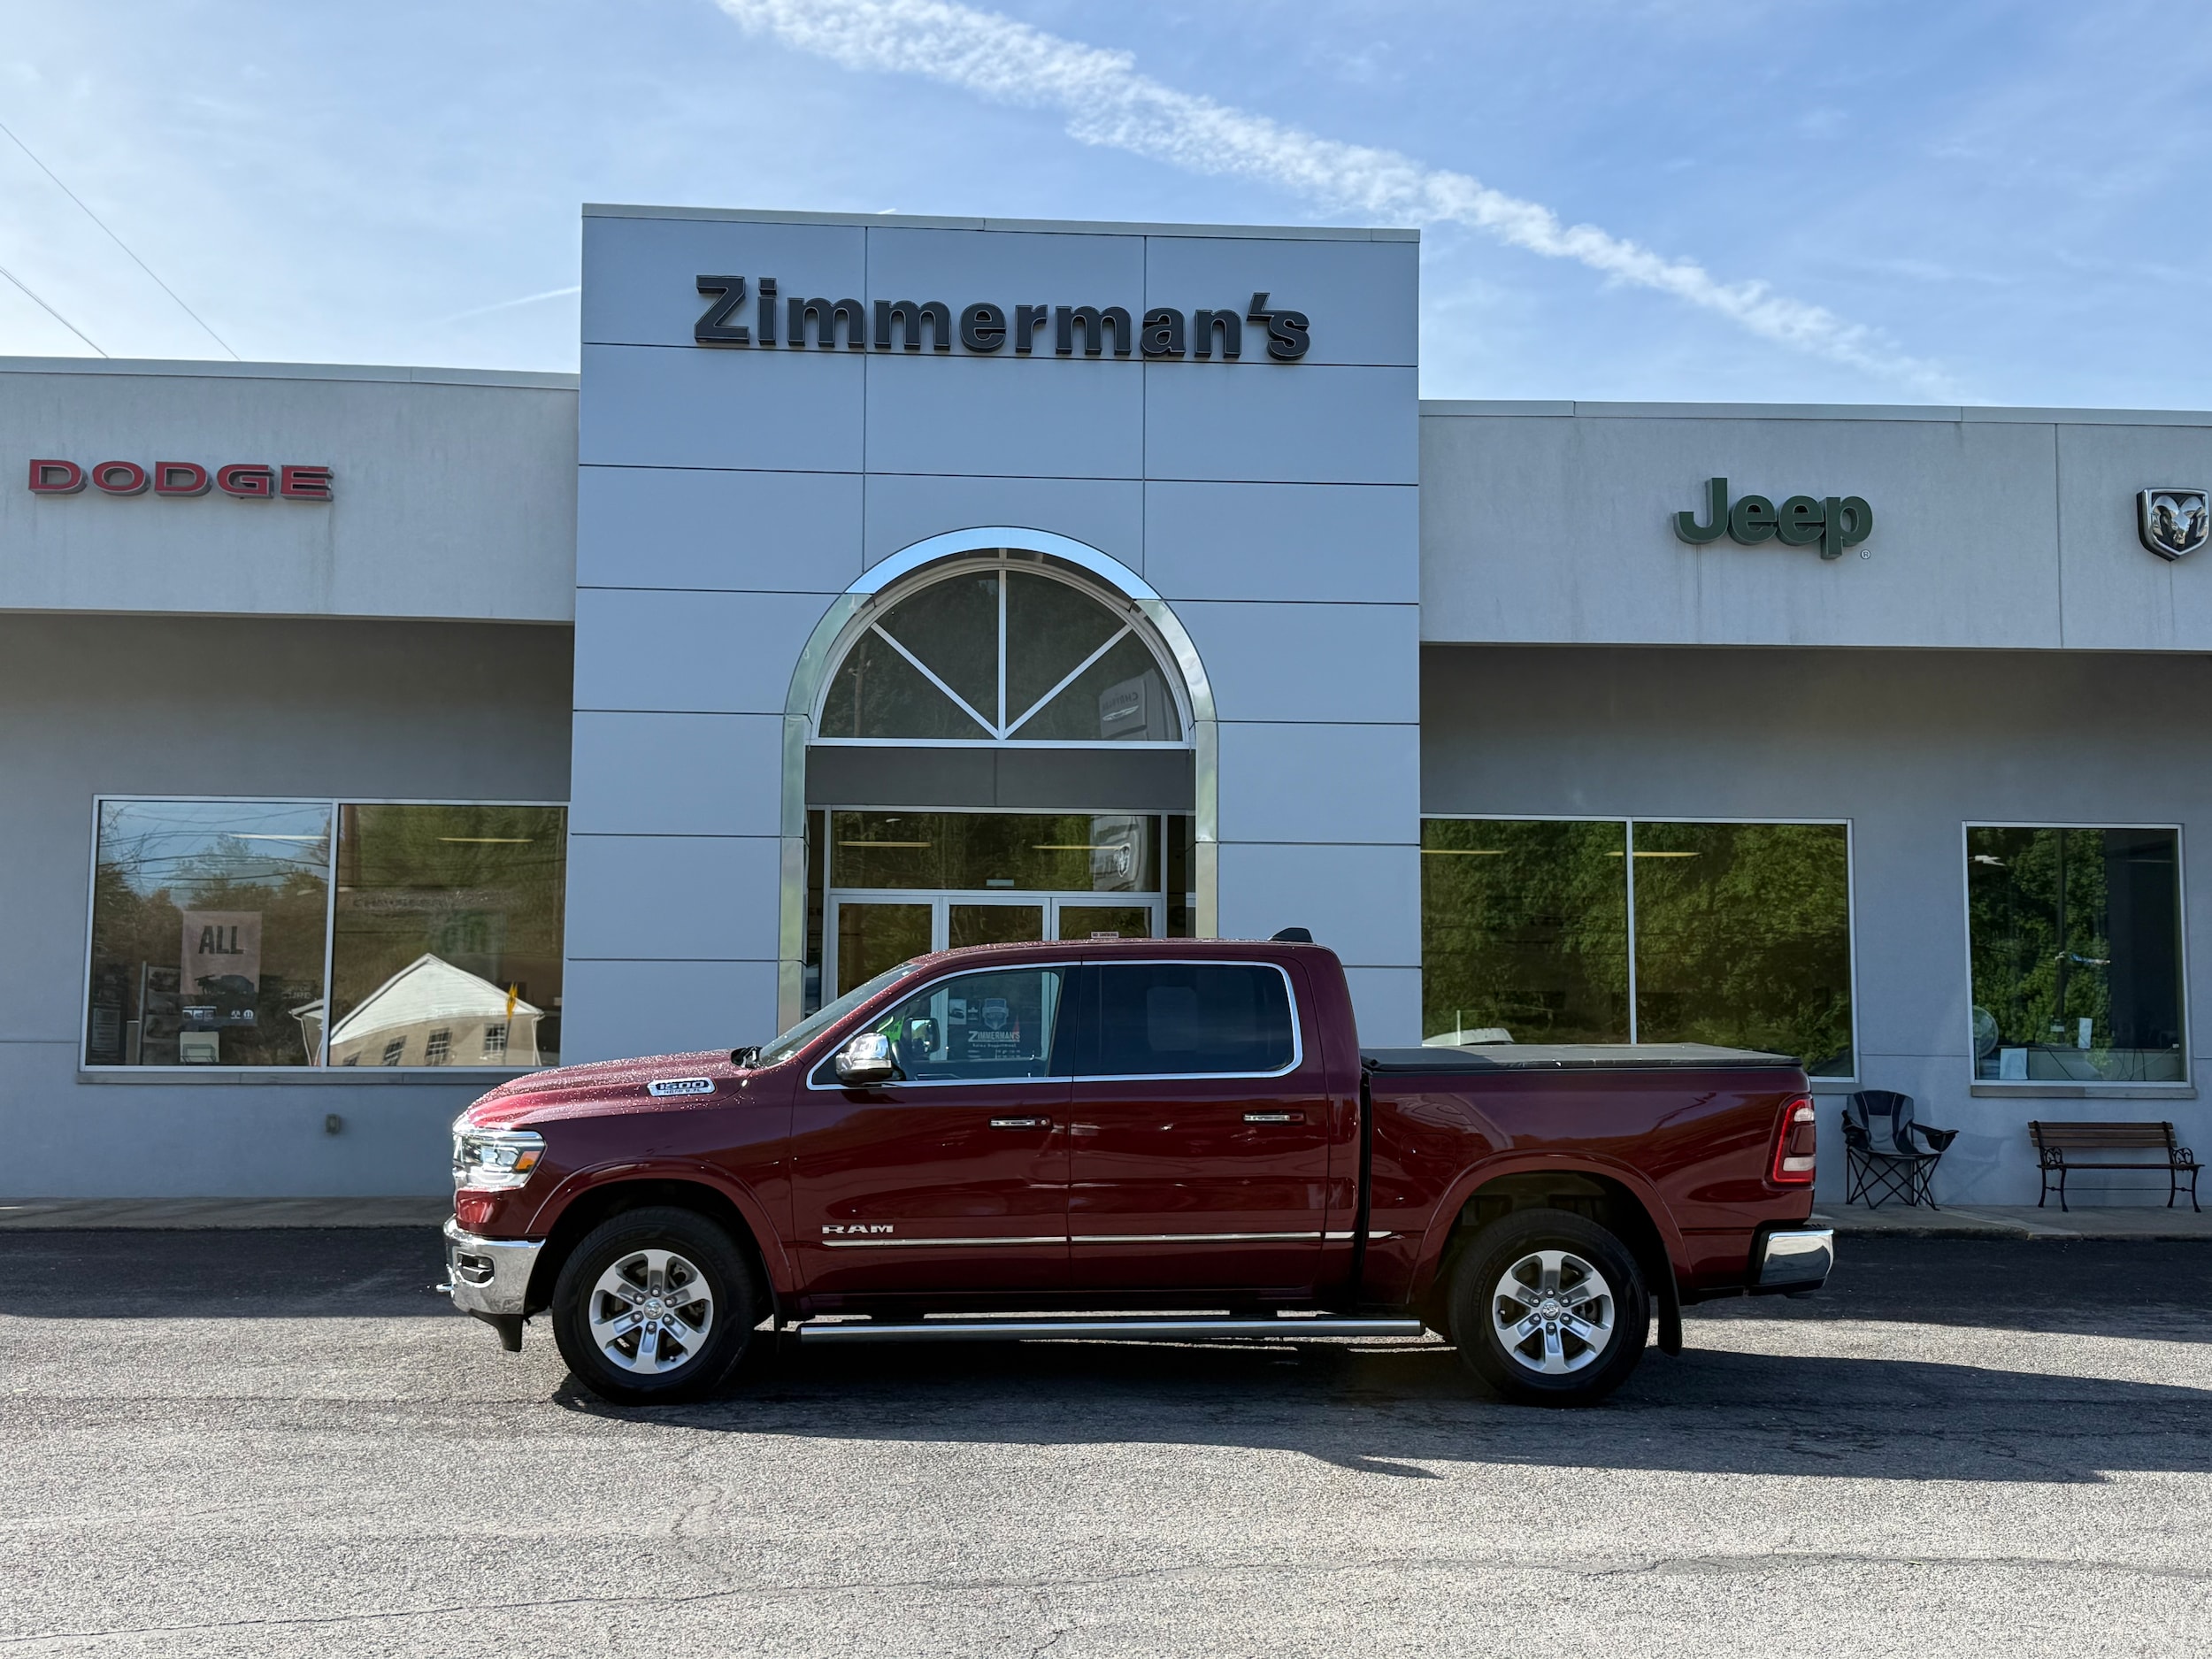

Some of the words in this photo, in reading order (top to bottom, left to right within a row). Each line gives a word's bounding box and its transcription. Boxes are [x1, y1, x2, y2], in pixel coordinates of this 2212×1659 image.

[694, 274, 1311, 361] Zimmerman's
[28, 458, 334, 502] DODGE
[1672, 478, 1873, 560] Jeep
[198, 925, 245, 955] ALL
[657, 1080, 708, 1091] 1500
[821, 1224, 894, 1234] RAM
